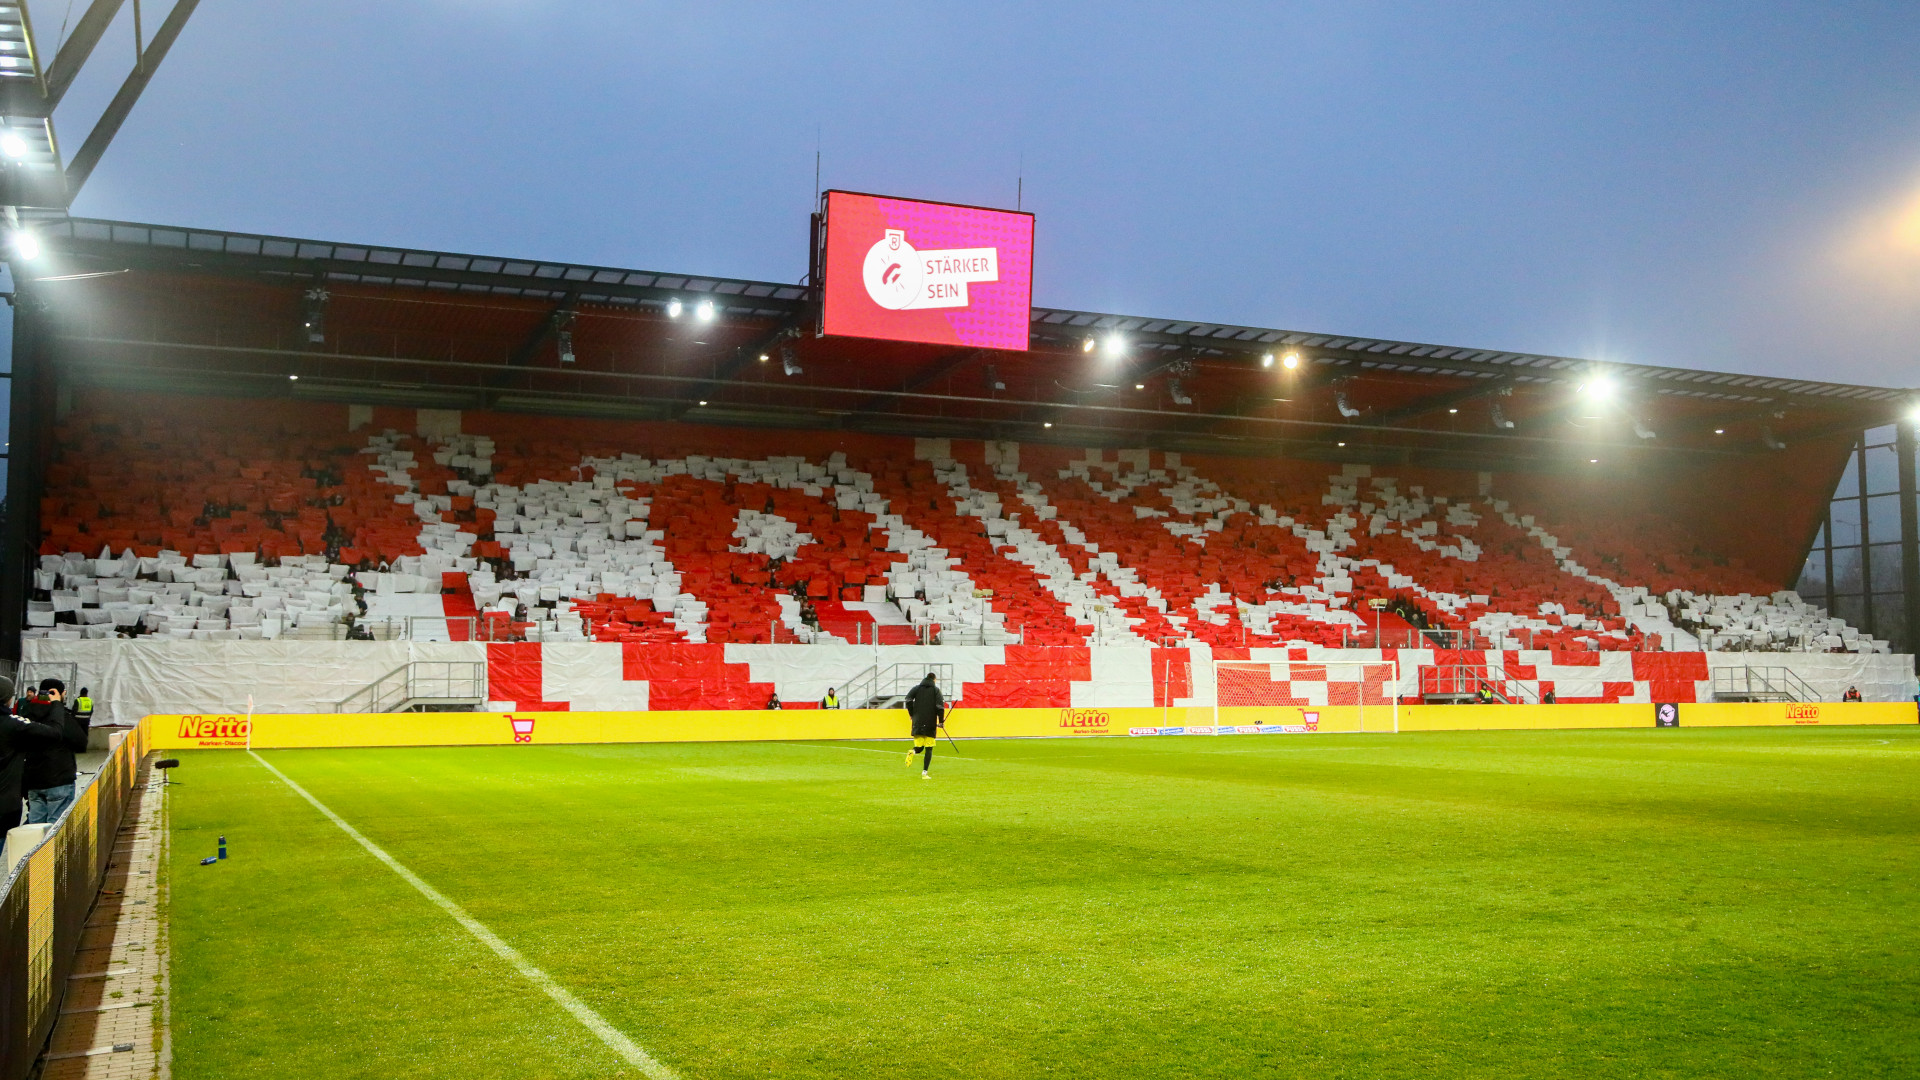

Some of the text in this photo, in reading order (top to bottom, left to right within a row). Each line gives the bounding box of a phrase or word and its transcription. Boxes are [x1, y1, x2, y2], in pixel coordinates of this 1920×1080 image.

[926, 256, 989, 275] STÄRKER
[928, 283, 959, 299] SEIN
[1060, 708, 1109, 727] Netto
[1786, 703, 1819, 719] Netto
[178, 716, 253, 738] Netto
